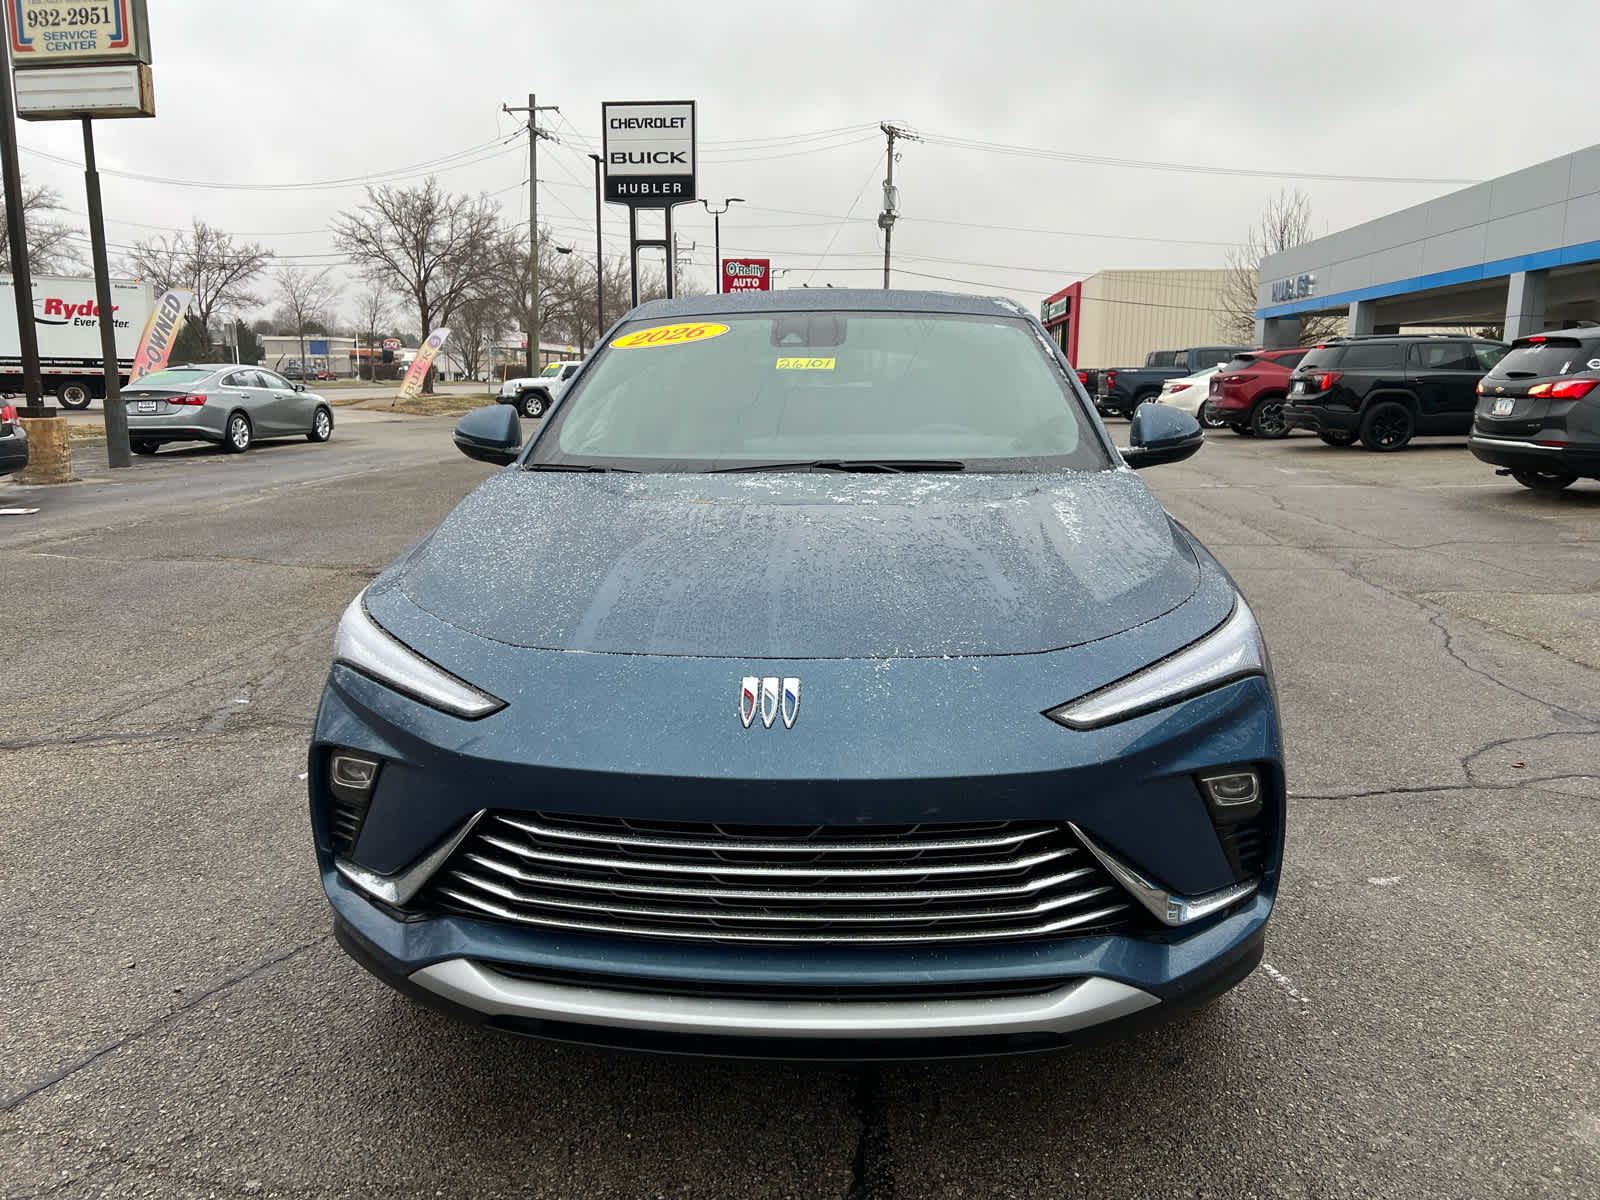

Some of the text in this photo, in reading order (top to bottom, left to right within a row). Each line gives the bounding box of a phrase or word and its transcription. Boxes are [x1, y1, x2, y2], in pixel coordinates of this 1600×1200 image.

[27, 7, 112, 27] 932-2951
[43, 30, 97, 41] SERVICE
[45, 41, 97, 51] CENTER
[610, 117, 687, 129] CHEVROLET
[610, 151, 688, 164] BUICK
[618, 183, 682, 194] HUBLER
[727, 262, 765, 277] O'Reilly
[732, 278, 760, 287] AUTO
[74, 317, 97, 327] Ever
[626, 324, 713, 346] 2026
